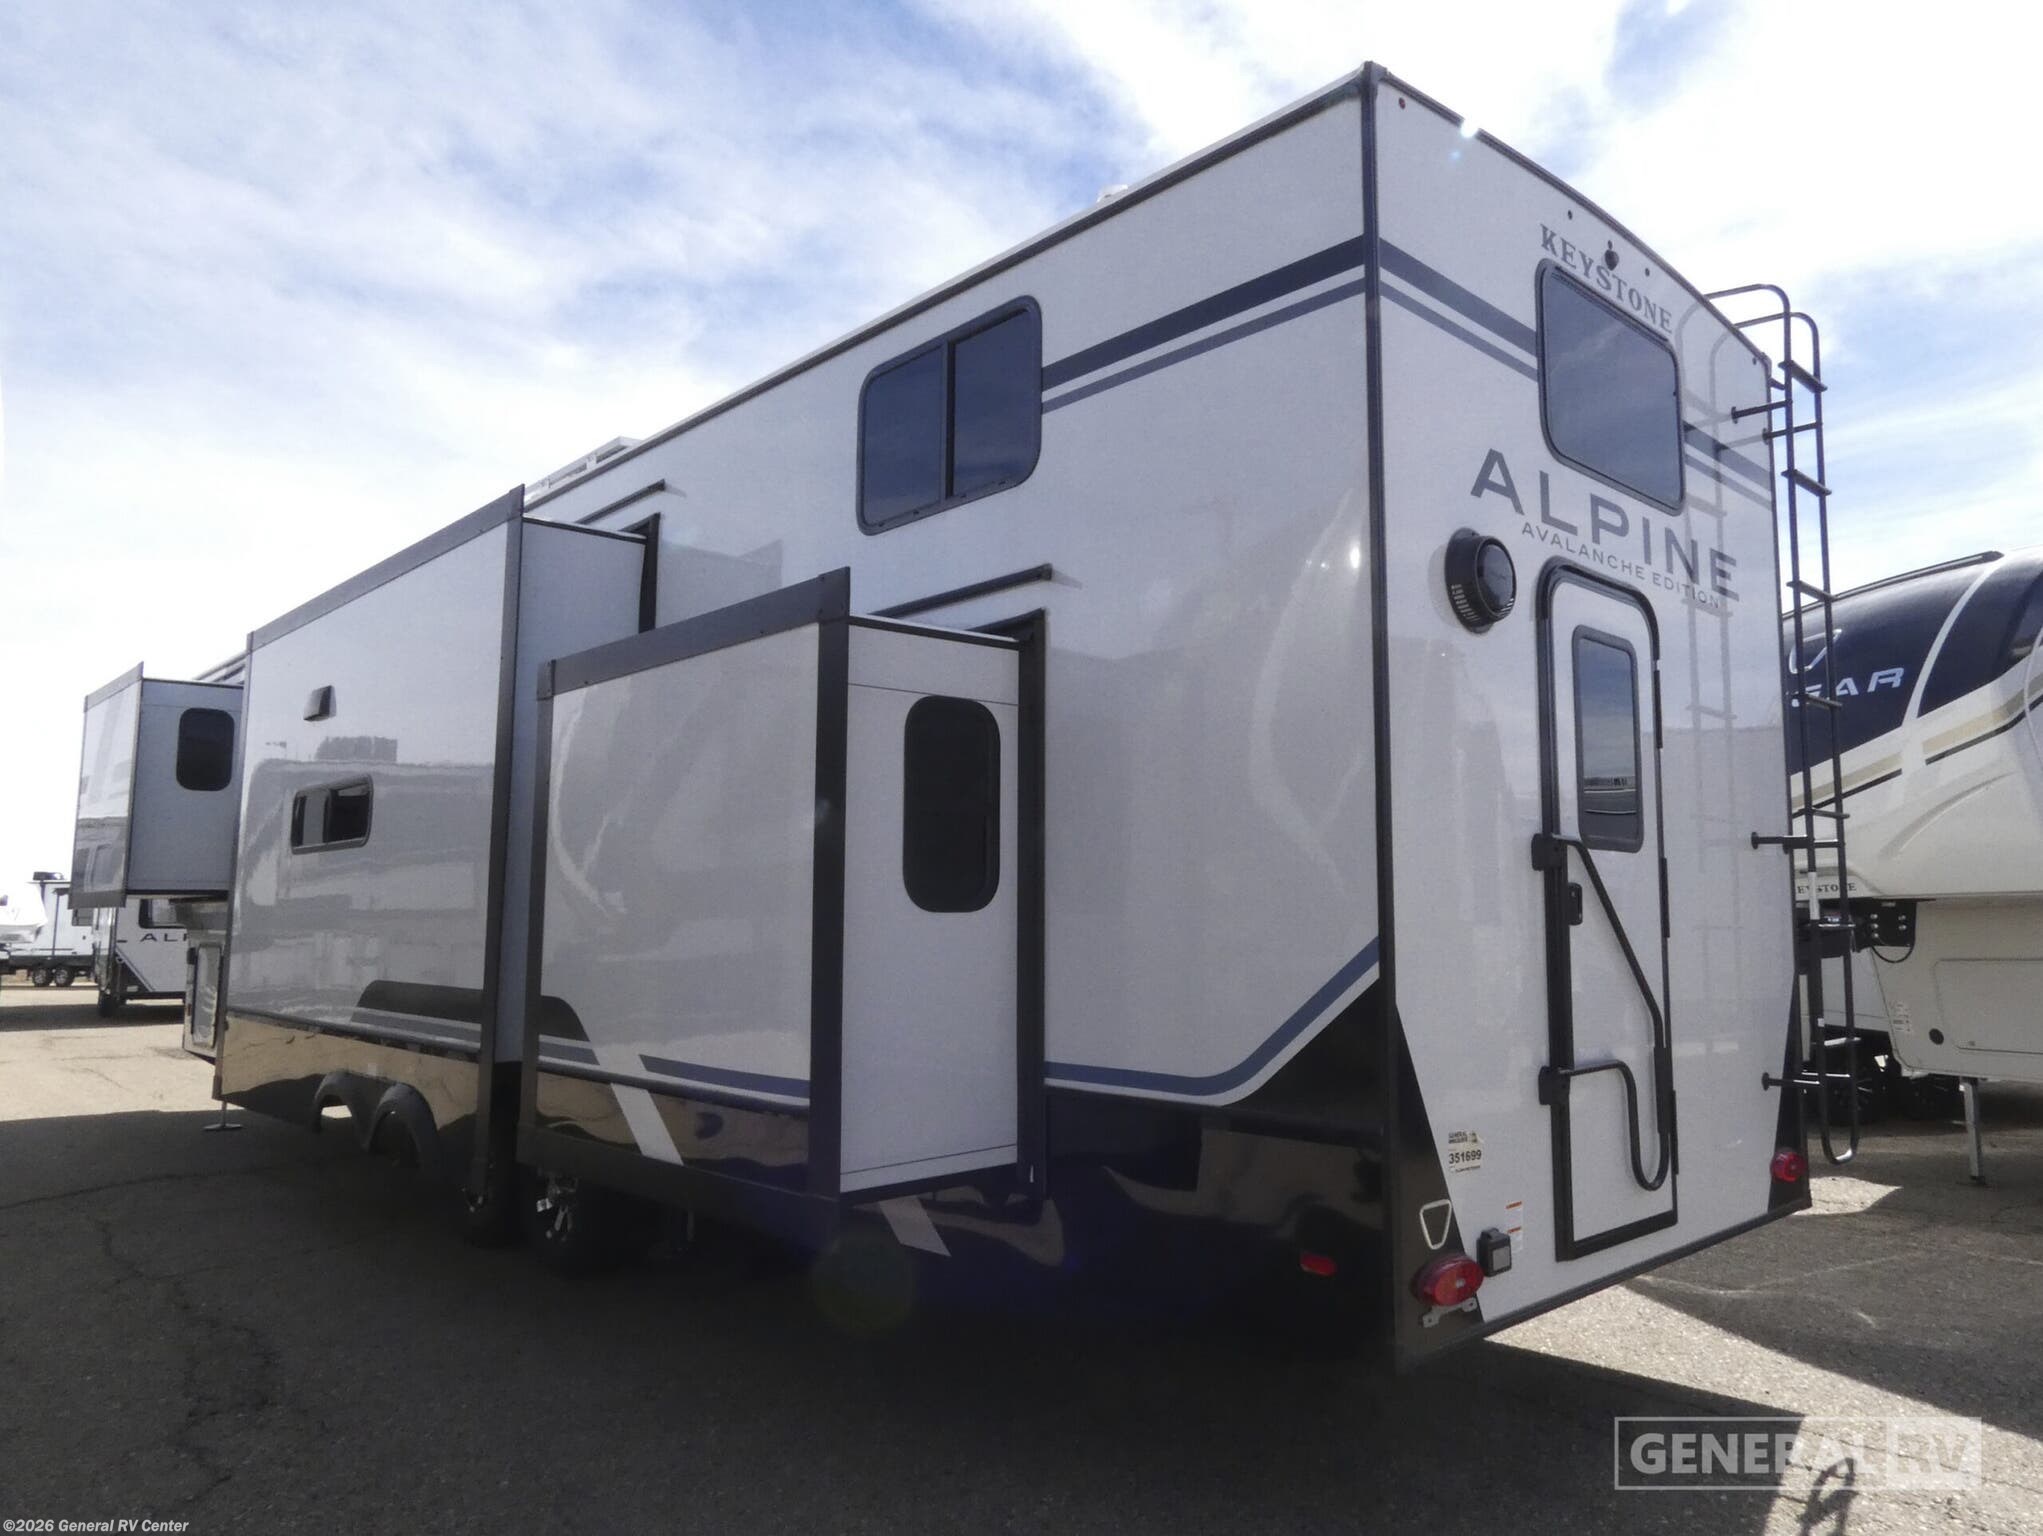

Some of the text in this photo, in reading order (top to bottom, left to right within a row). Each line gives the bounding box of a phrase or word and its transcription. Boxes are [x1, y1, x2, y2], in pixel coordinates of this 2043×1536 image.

[1540, 223, 1673, 334] KEYSTONE
[1470, 447, 1739, 602] ALPINE
[1522, 521, 1720, 609] AVALANCHE EDITION
[1448, 1150, 1482, 1164] 351699
